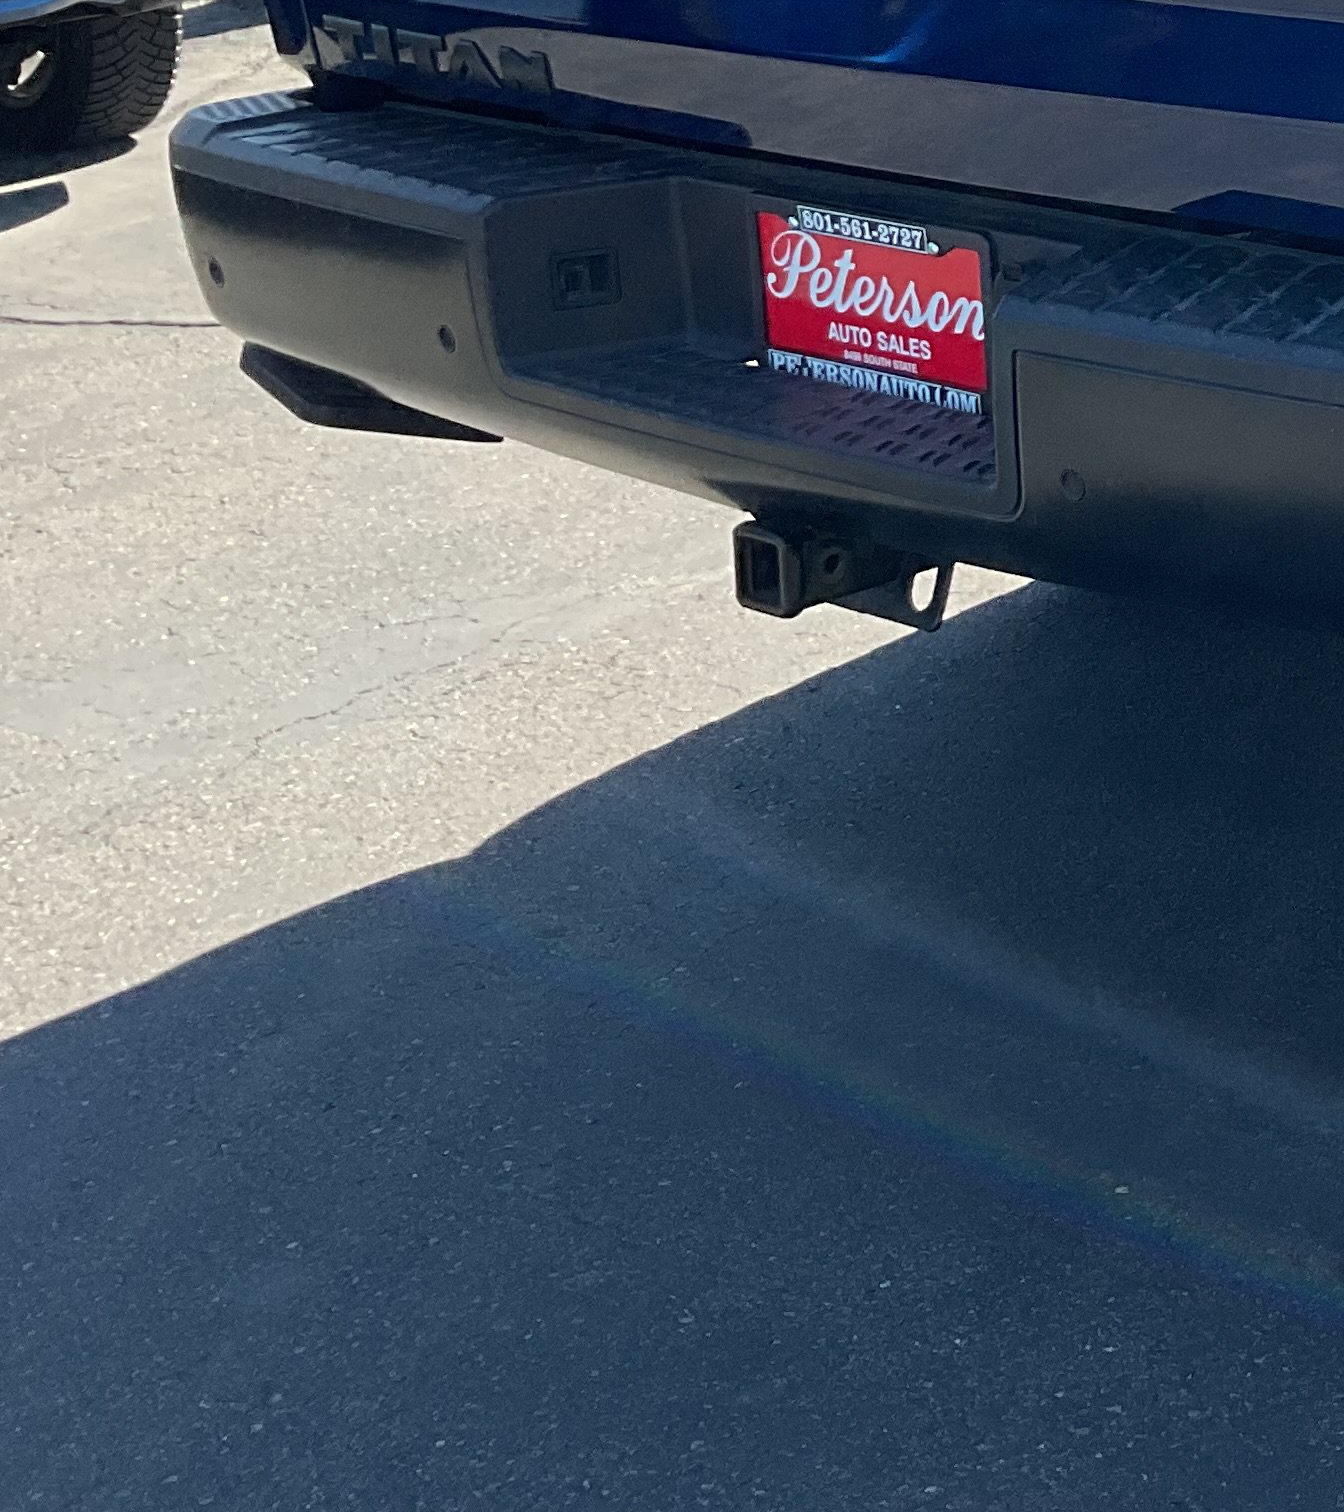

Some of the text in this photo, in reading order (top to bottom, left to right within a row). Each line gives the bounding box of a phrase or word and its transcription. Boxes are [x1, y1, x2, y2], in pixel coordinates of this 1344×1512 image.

[321, 13, 555, 91] TITAN
[801, 210, 923, 250] 801-561-2727
[766, 230, 986, 341] Peterson
[827, 321, 932, 361] AUTO SALES
[863, 353, 892, 368] SOUTH
[892, 359, 919, 374] STATE
